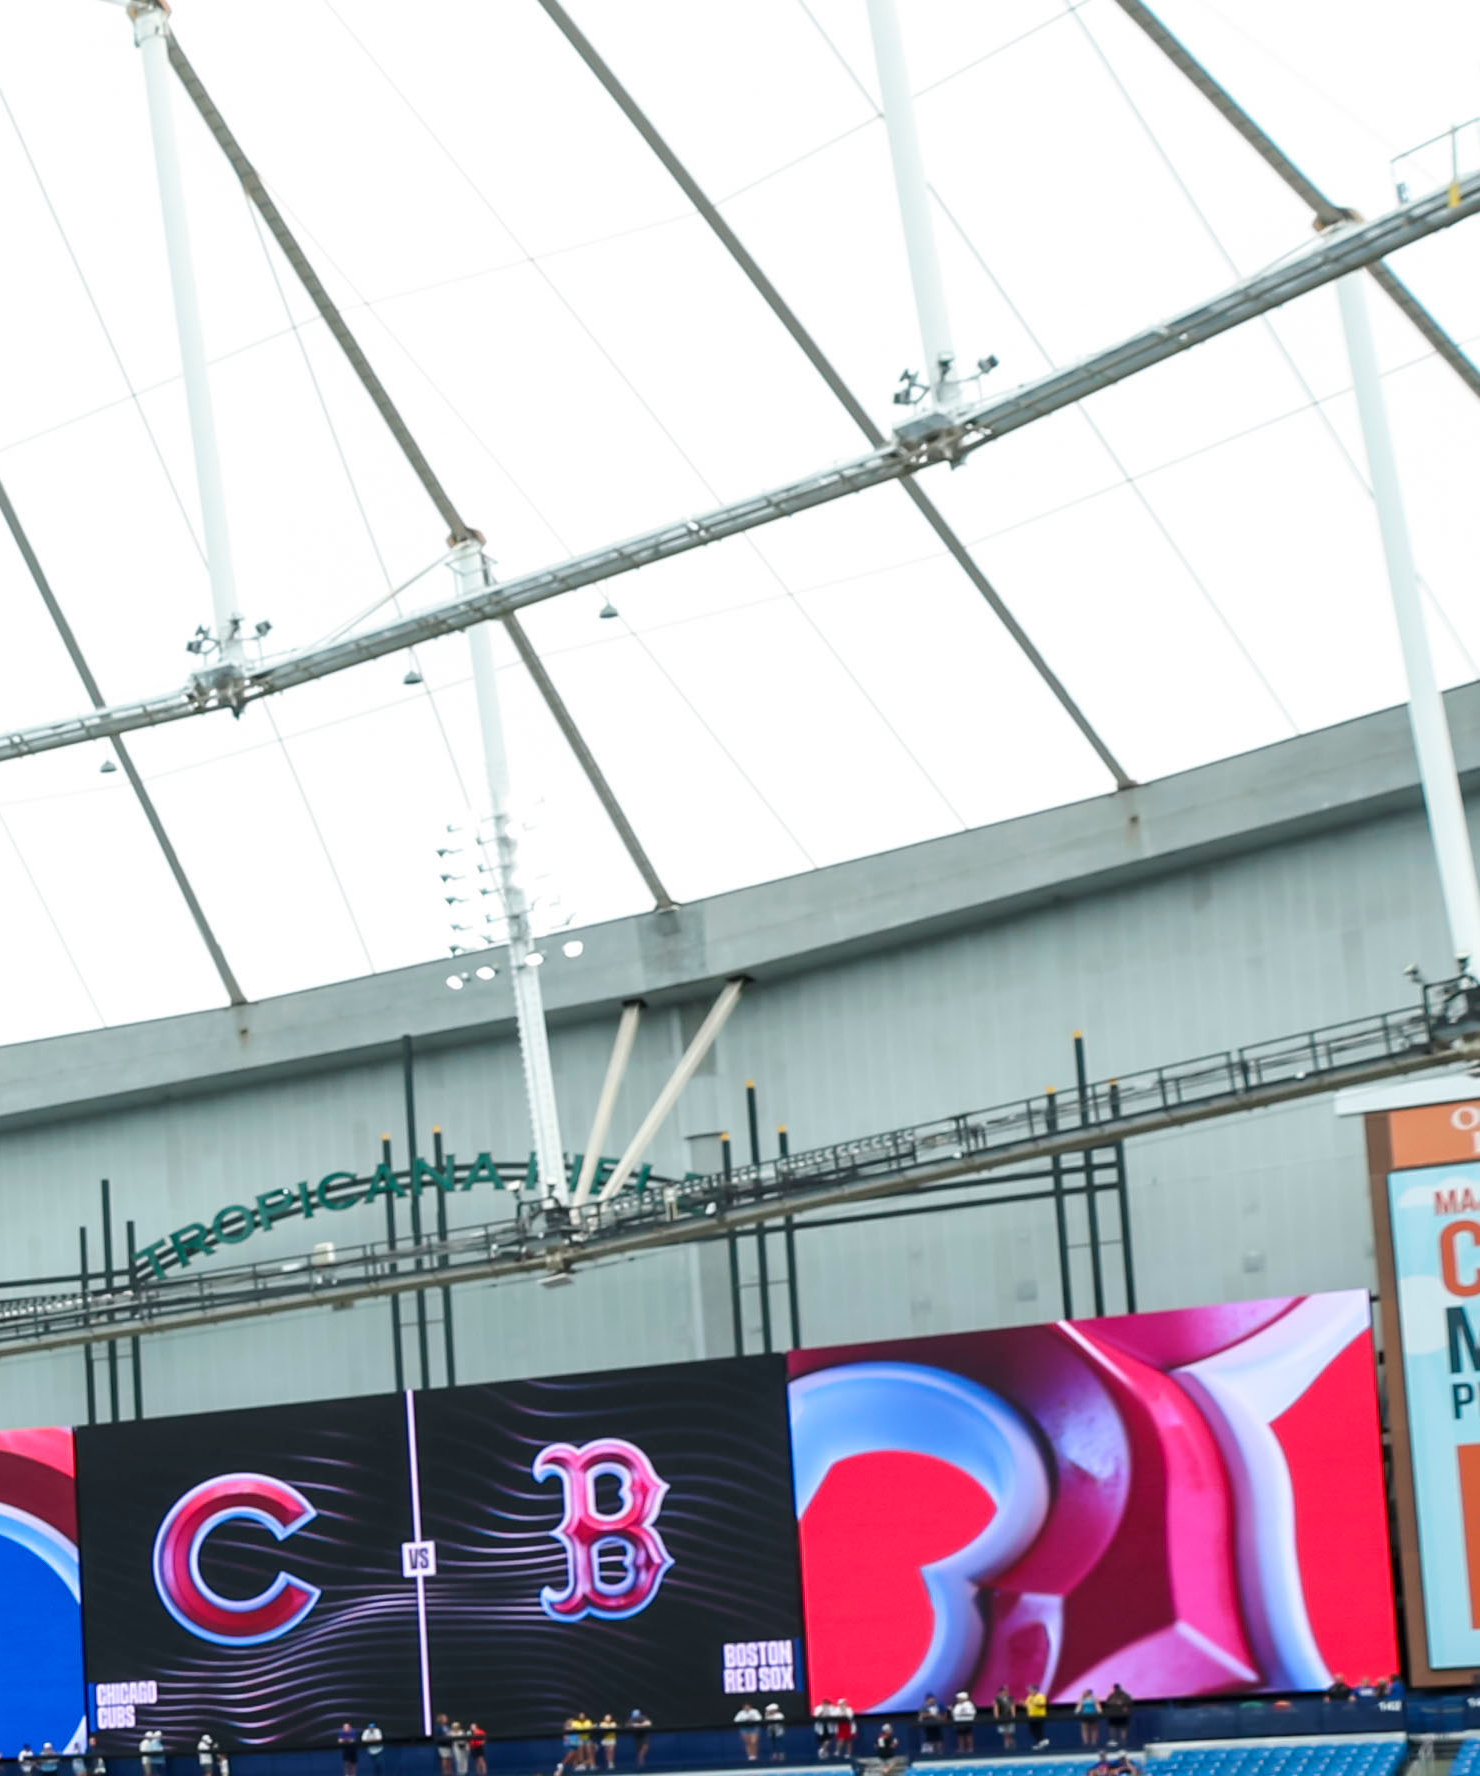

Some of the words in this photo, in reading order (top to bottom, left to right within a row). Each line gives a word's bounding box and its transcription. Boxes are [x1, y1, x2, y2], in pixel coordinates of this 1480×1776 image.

[133, 1151, 506, 1281] TROPICANA
[532, 1437, 675, 1624] B
[152, 1472, 322, 1647] C
[408, 1549, 430, 1569] VS
[723, 1639, 793, 1668] BOSTON
[96, 1680, 158, 1706] CHICAGO
[723, 1667, 758, 1694] RED
[758, 1665, 795, 1692] SOX
[97, 1705, 137, 1729] CUBS
